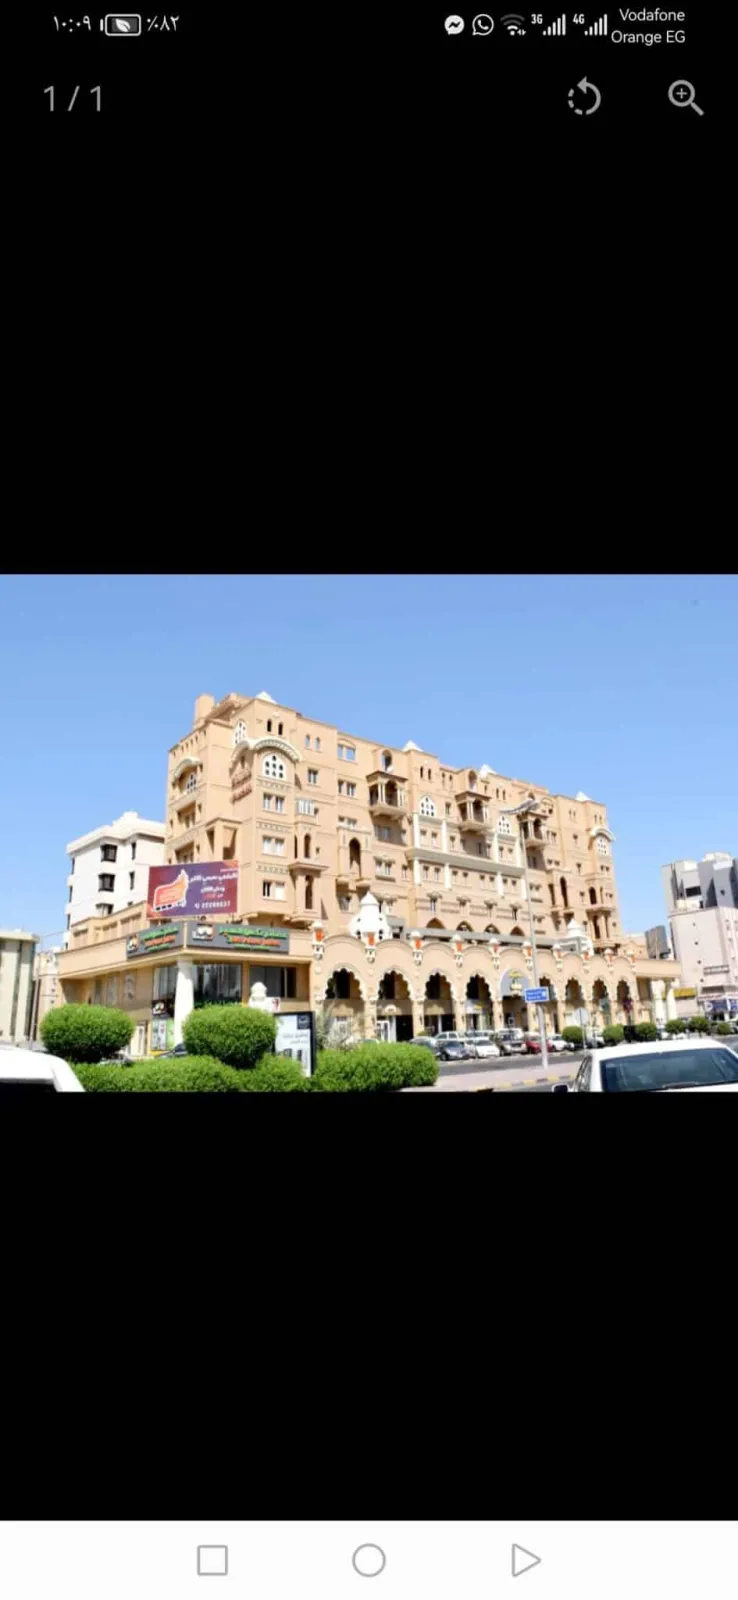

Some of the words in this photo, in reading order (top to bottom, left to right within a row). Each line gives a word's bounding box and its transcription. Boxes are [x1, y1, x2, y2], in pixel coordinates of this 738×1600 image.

[530, 13, 543, 25] 3G
[572, 13, 585, 25] 4G
[618, 7, 686, 22] Vodafone
[610, 29, 662, 47] Orange
[666, 29, 686, 44] EG
